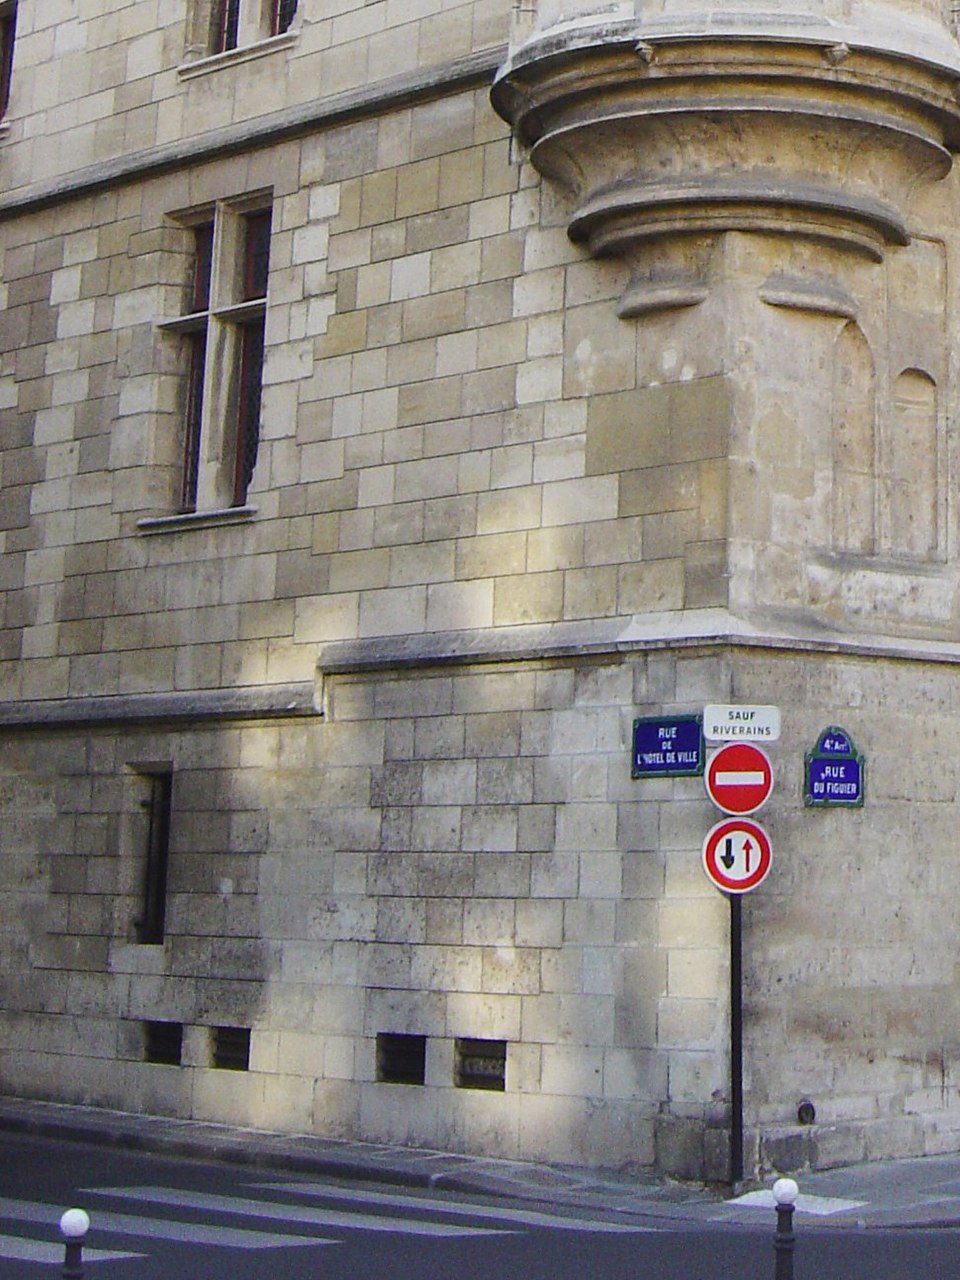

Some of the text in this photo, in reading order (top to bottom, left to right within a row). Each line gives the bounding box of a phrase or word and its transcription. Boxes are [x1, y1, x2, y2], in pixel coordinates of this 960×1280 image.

[728, 710, 756, 721] SAUF
[658, 727, 677, 739] RUE
[712, 725, 772, 736] RIVERAINS
[662, 741, 672, 750] DE
[666, 751, 676, 764] DE
[677, 751, 698, 763] VILLE
[825, 766, 845, 778] RUE
[813, 782, 857, 794] DU FIGUIER
